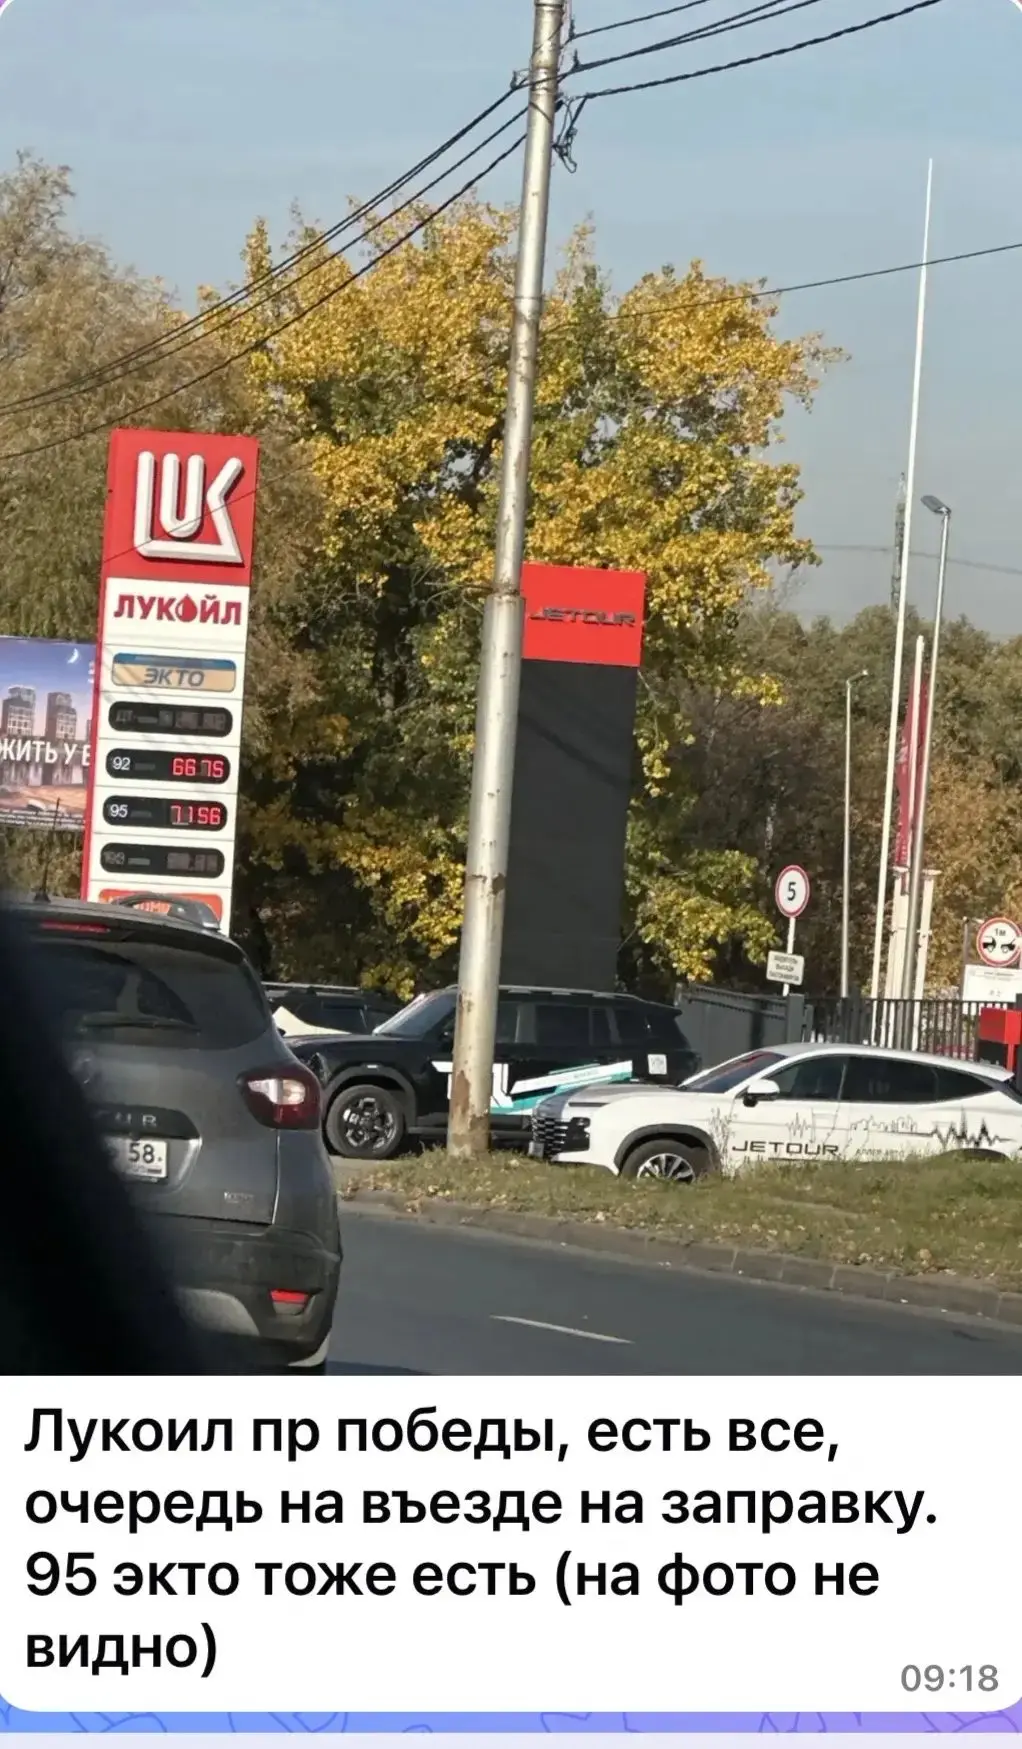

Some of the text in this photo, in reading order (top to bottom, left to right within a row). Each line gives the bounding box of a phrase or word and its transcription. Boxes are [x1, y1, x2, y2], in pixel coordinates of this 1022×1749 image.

[113, 593, 242, 626] ЛУКОЙЛ
[529, 606, 636, 628] JETOUR
[143, 667, 205, 687] ЭКТО
[112, 756, 131, 770] 92
[110, 803, 128, 818] 95
[787, 881, 797, 902] 5
[128, 1142, 155, 1164] 58
[732, 1140, 840, 1156] JETOUR
